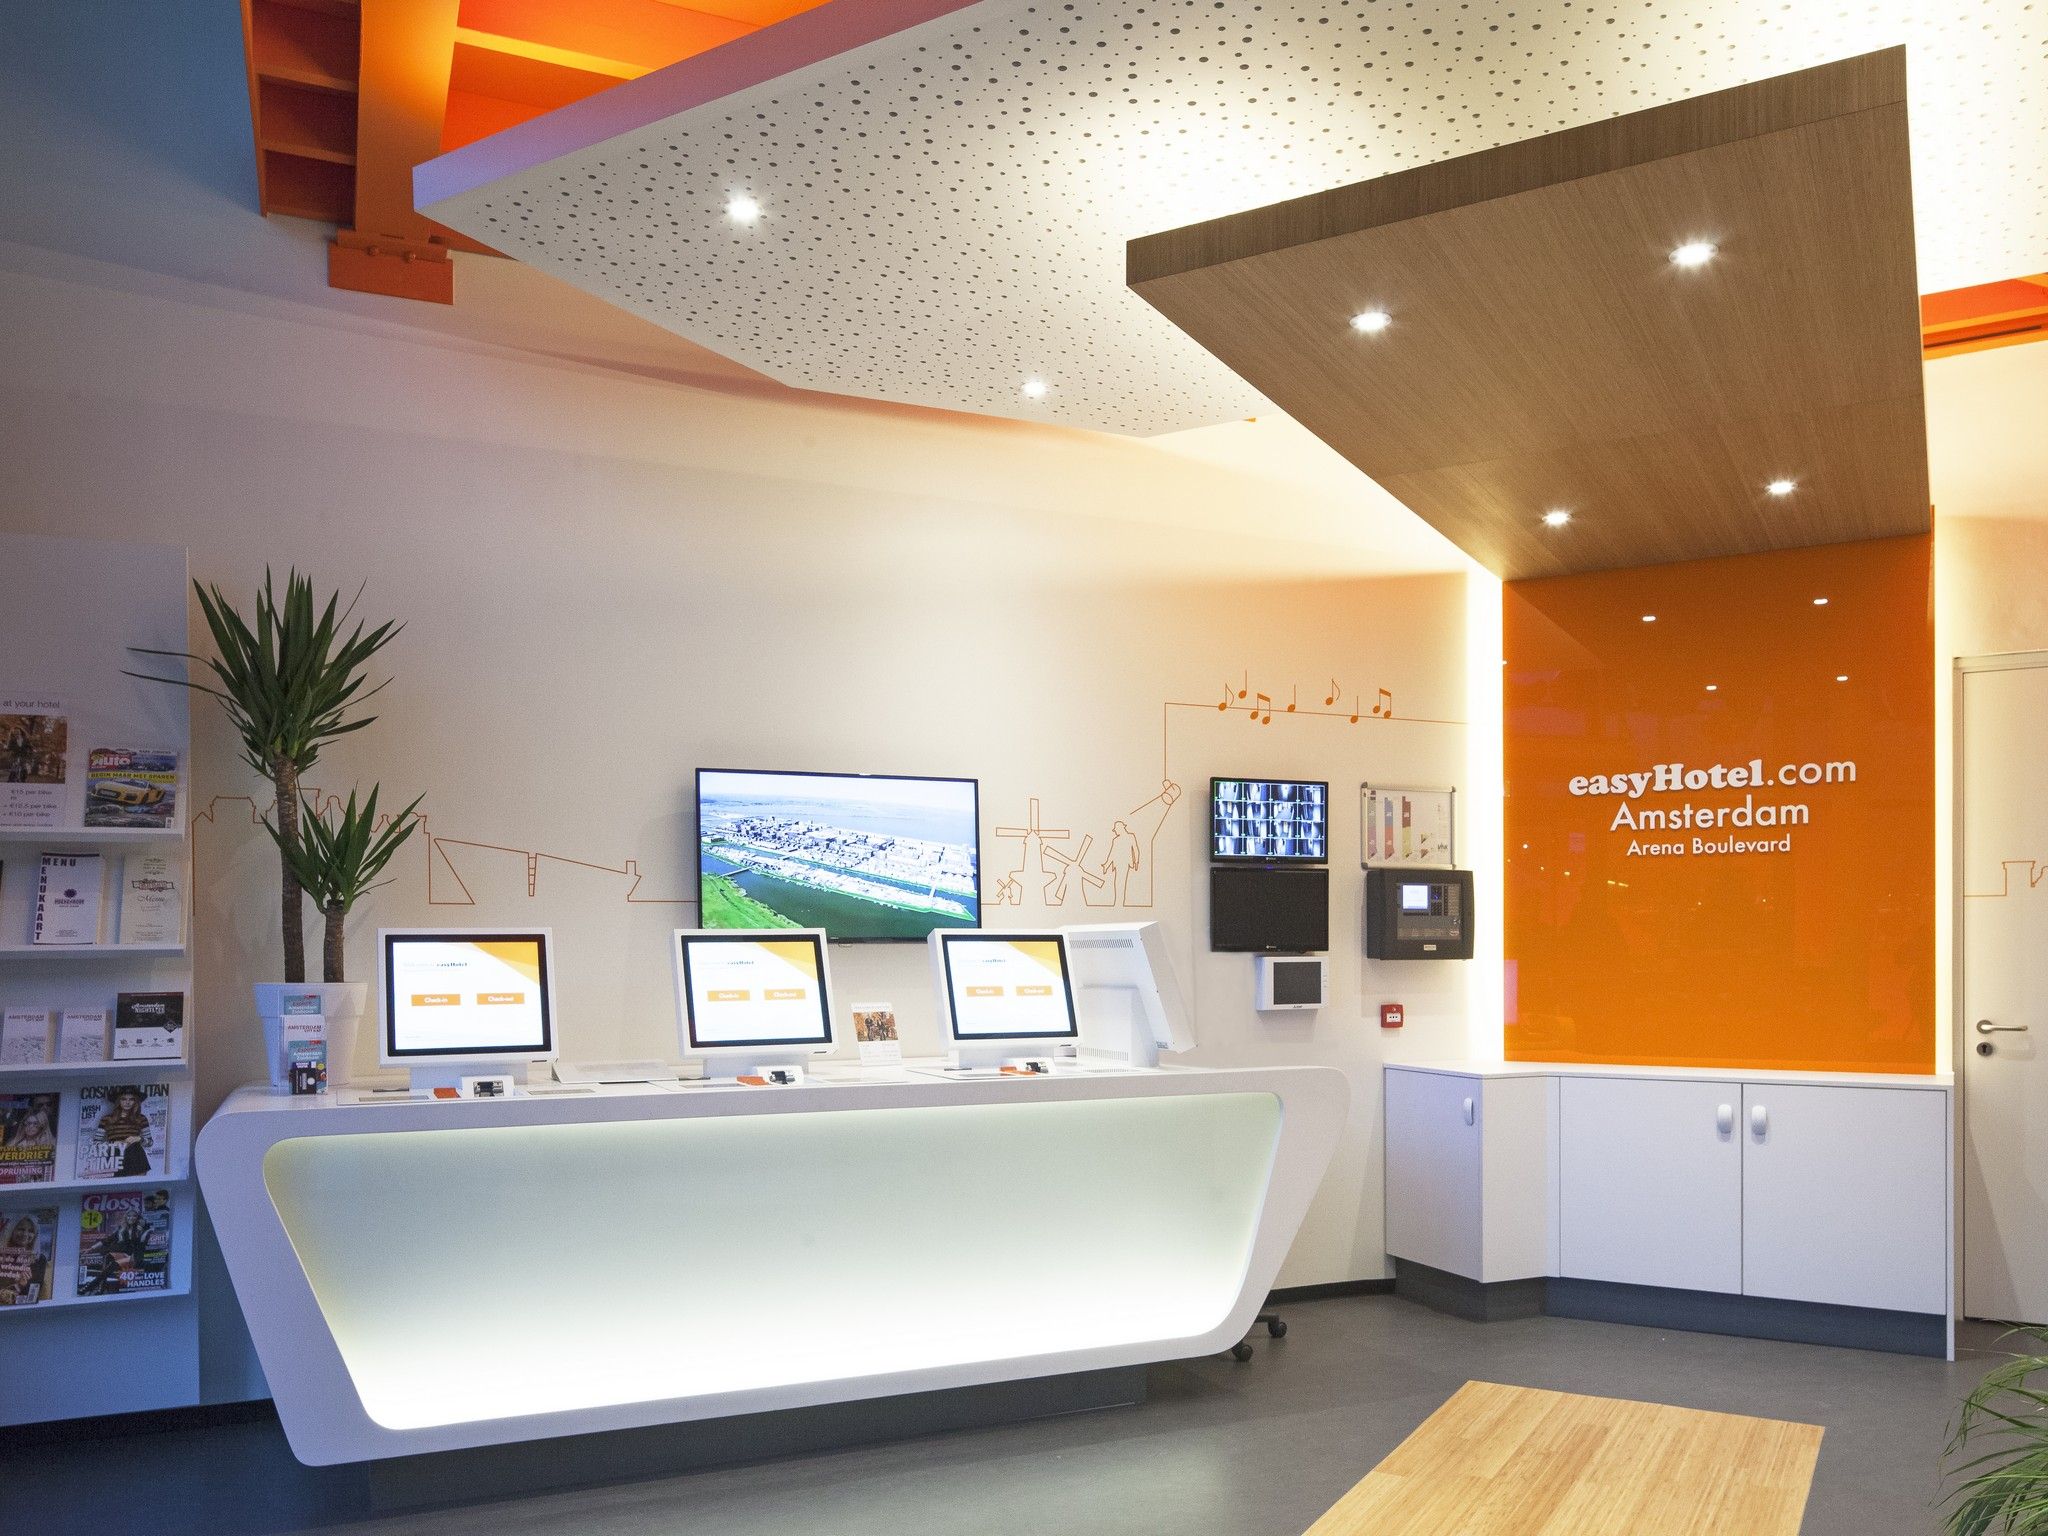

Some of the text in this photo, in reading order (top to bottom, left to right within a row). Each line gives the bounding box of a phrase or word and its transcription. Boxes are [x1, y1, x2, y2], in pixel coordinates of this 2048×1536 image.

[15, 701, 35, 709] your
[37, 700, 60, 708] hotel
[1568, 759, 1857, 799] easyHotel.com
[1610, 794, 1809, 832] Amsterdam
[1626, 834, 1791, 856] Arena Boulevard
[42, 857, 77, 867] MENU
[80, 1084, 169, 1099] COSMLITAN
[81, 1104, 101, 1112] WISH
[81, 1112, 97, 1120] LIST
[79, 1142, 127, 1159] PARTY
[86, 1156, 124, 1171] TIME
[83, 1194, 140, 1212] Gloss
[144, 1271, 165, 1279] LOVE
[127, 1279, 165, 1287] HANDLES
